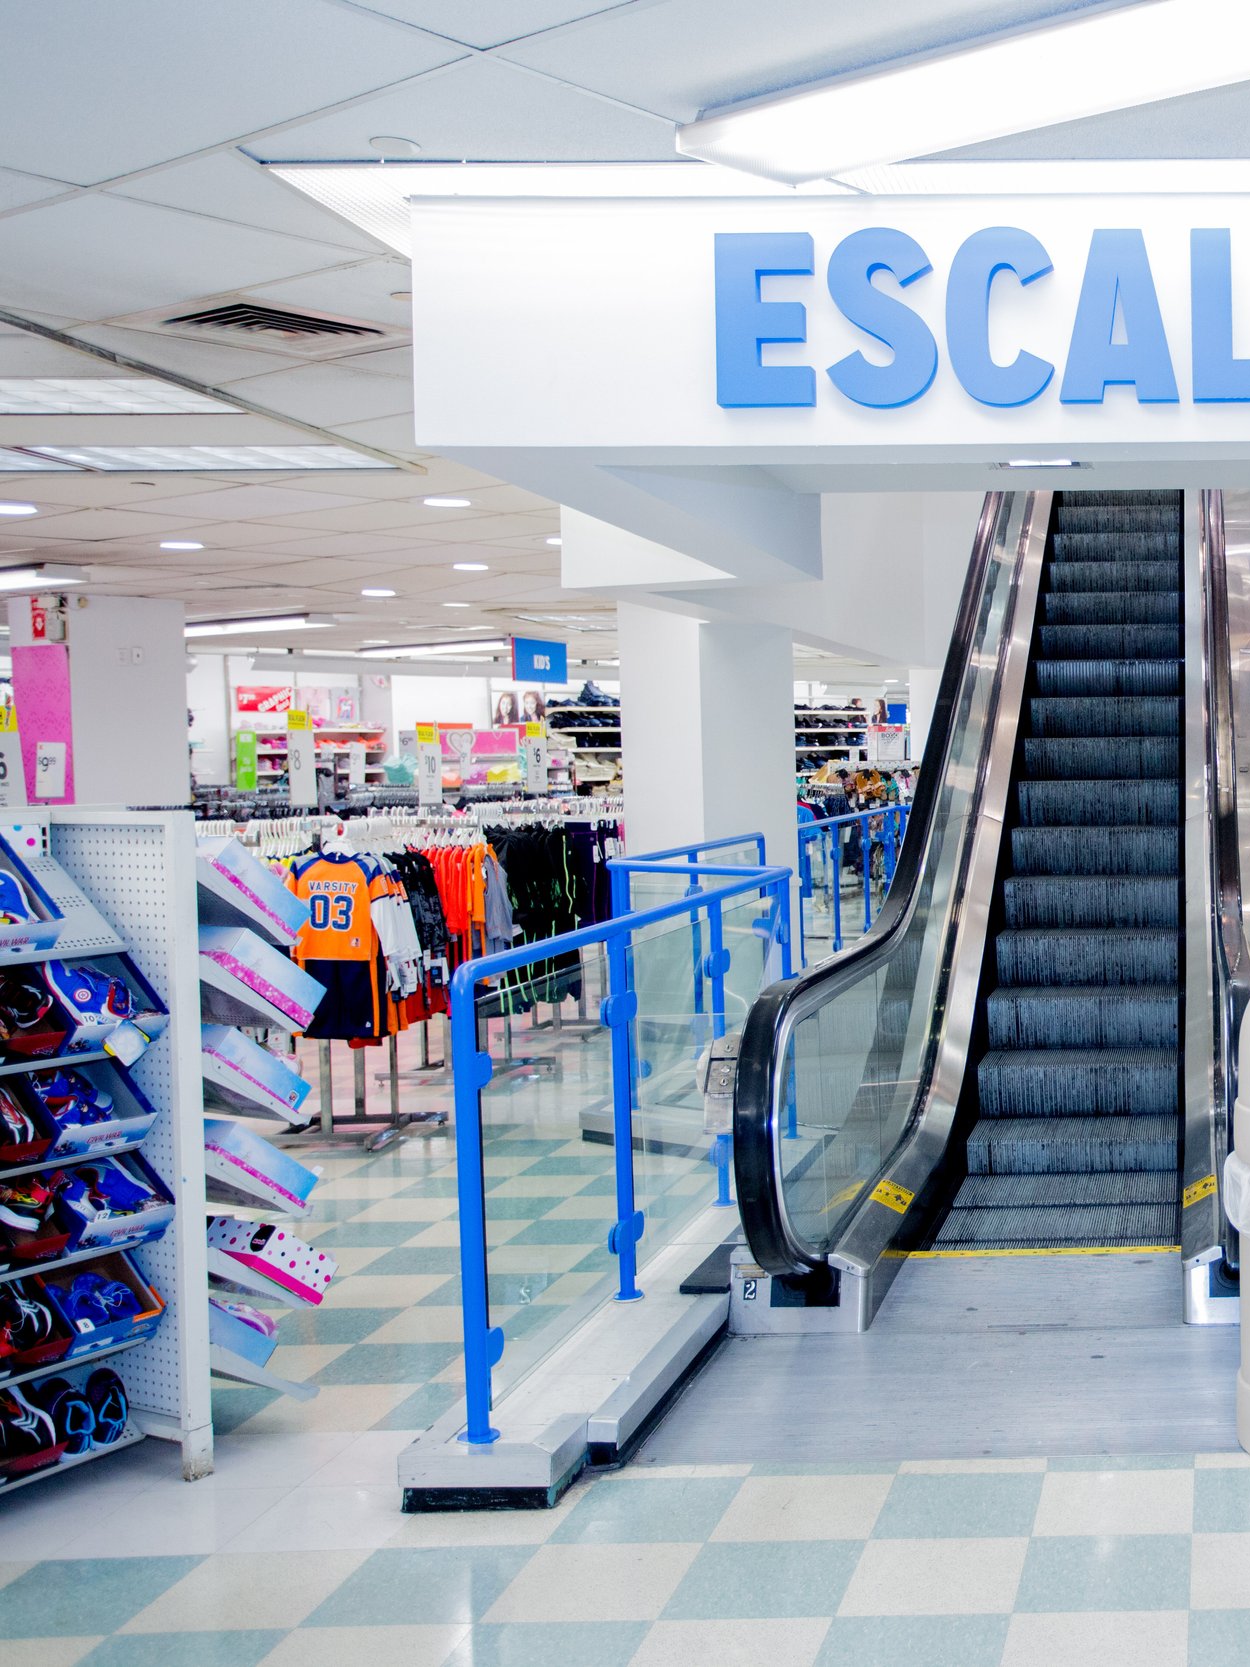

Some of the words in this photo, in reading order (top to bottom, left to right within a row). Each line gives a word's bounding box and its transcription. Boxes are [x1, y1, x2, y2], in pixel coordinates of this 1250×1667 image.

[308, 881, 358, 893] VARSITY
[309, 893, 354, 932] 03
[745, 1280, 756, 1299] 2
